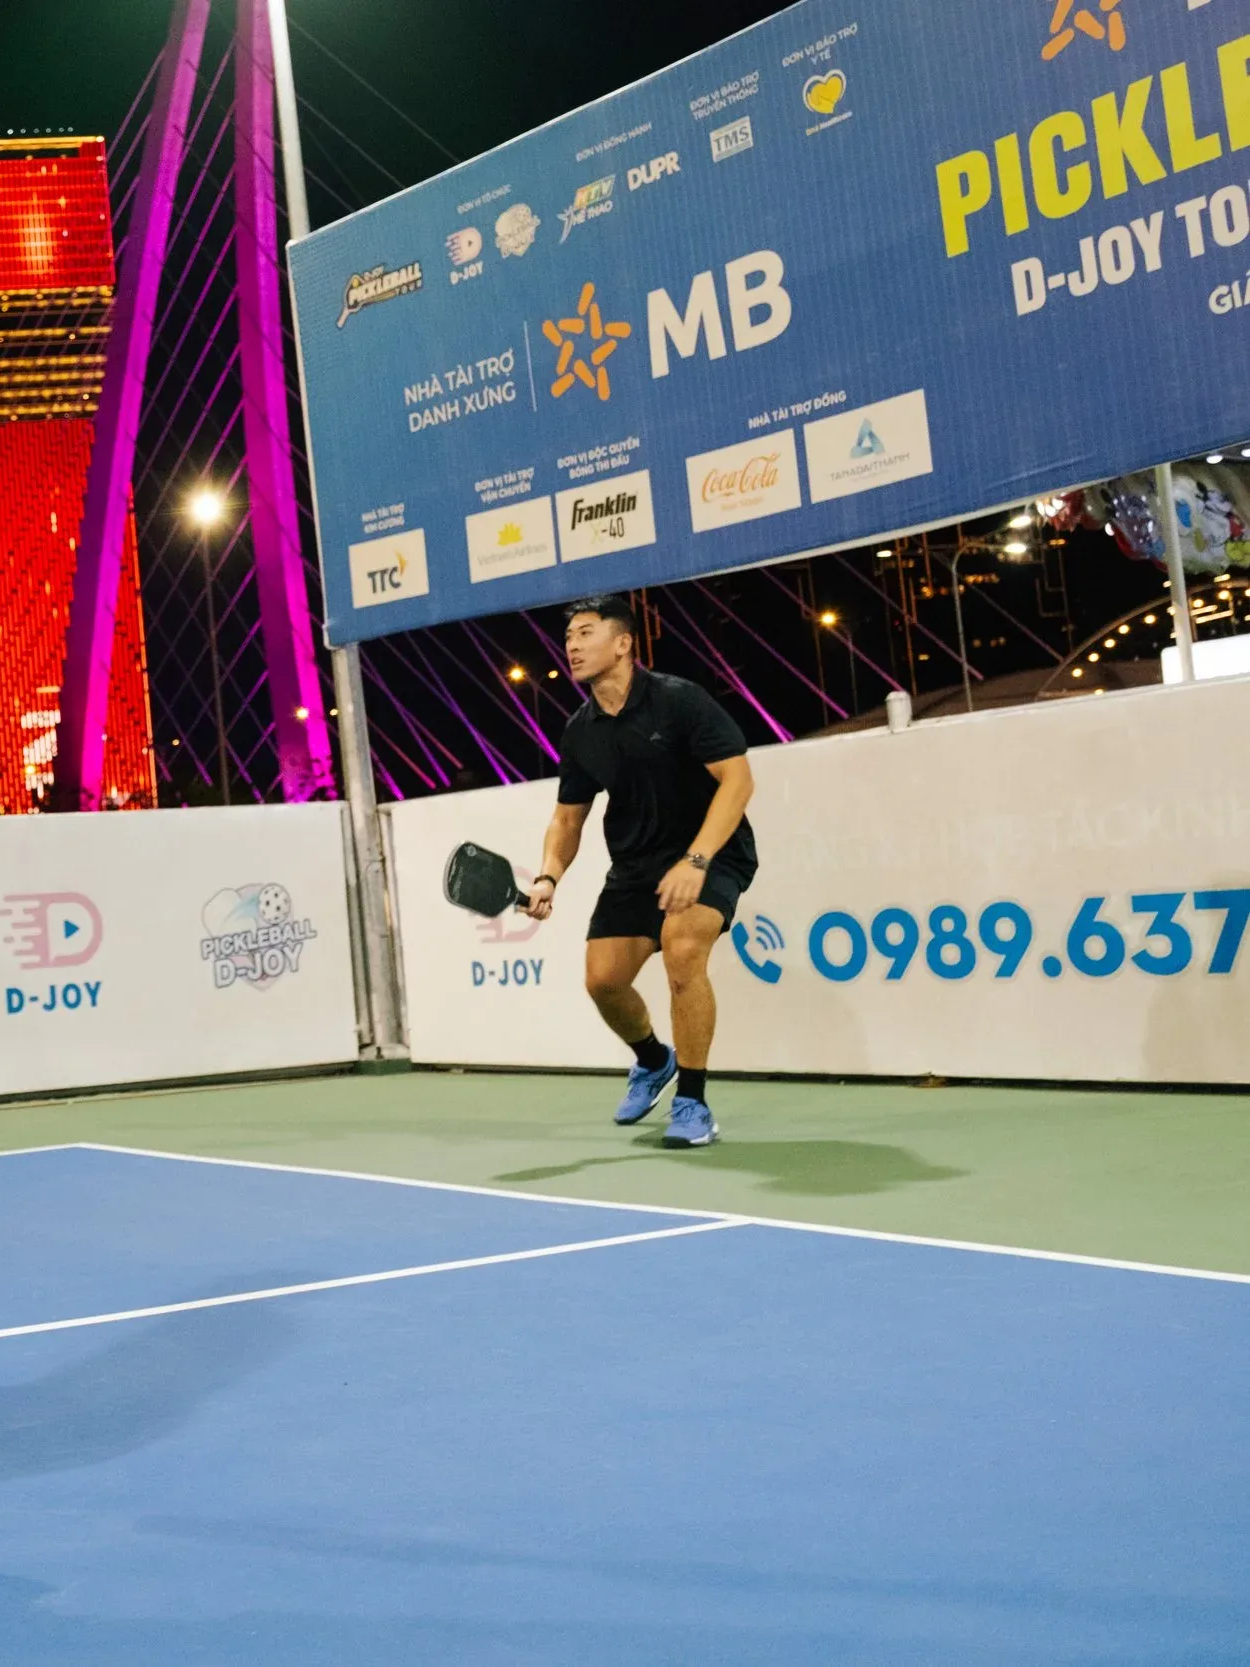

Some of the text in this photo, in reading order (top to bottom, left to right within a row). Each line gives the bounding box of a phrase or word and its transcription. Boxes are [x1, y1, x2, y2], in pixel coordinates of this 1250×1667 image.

[713, 126, 749, 152] TMS
[627, 151, 681, 191] DUPR
[1011, 179, 1250, 316] D-JOY TO
[450, 261, 483, 285] D-JOY
[647, 249, 792, 379] MB
[404, 347, 515, 406] NHÀ TÀI TRỢ
[409, 380, 517, 433] DANH XƯNG
[748, 415, 771, 430] NHÀ
[772, 407, 789, 423] TÀI
[791, 399, 812, 418] TRỢ
[367, 564, 402, 595] TTC
[200, 918, 318, 961] PICKLEBALL
[808, 888, 1250, 982] 0989.637
[213, 941, 304, 990] D-JOY
[471, 958, 545, 987] D-JOY
[5, 980, 102, 1015] D-JOY
